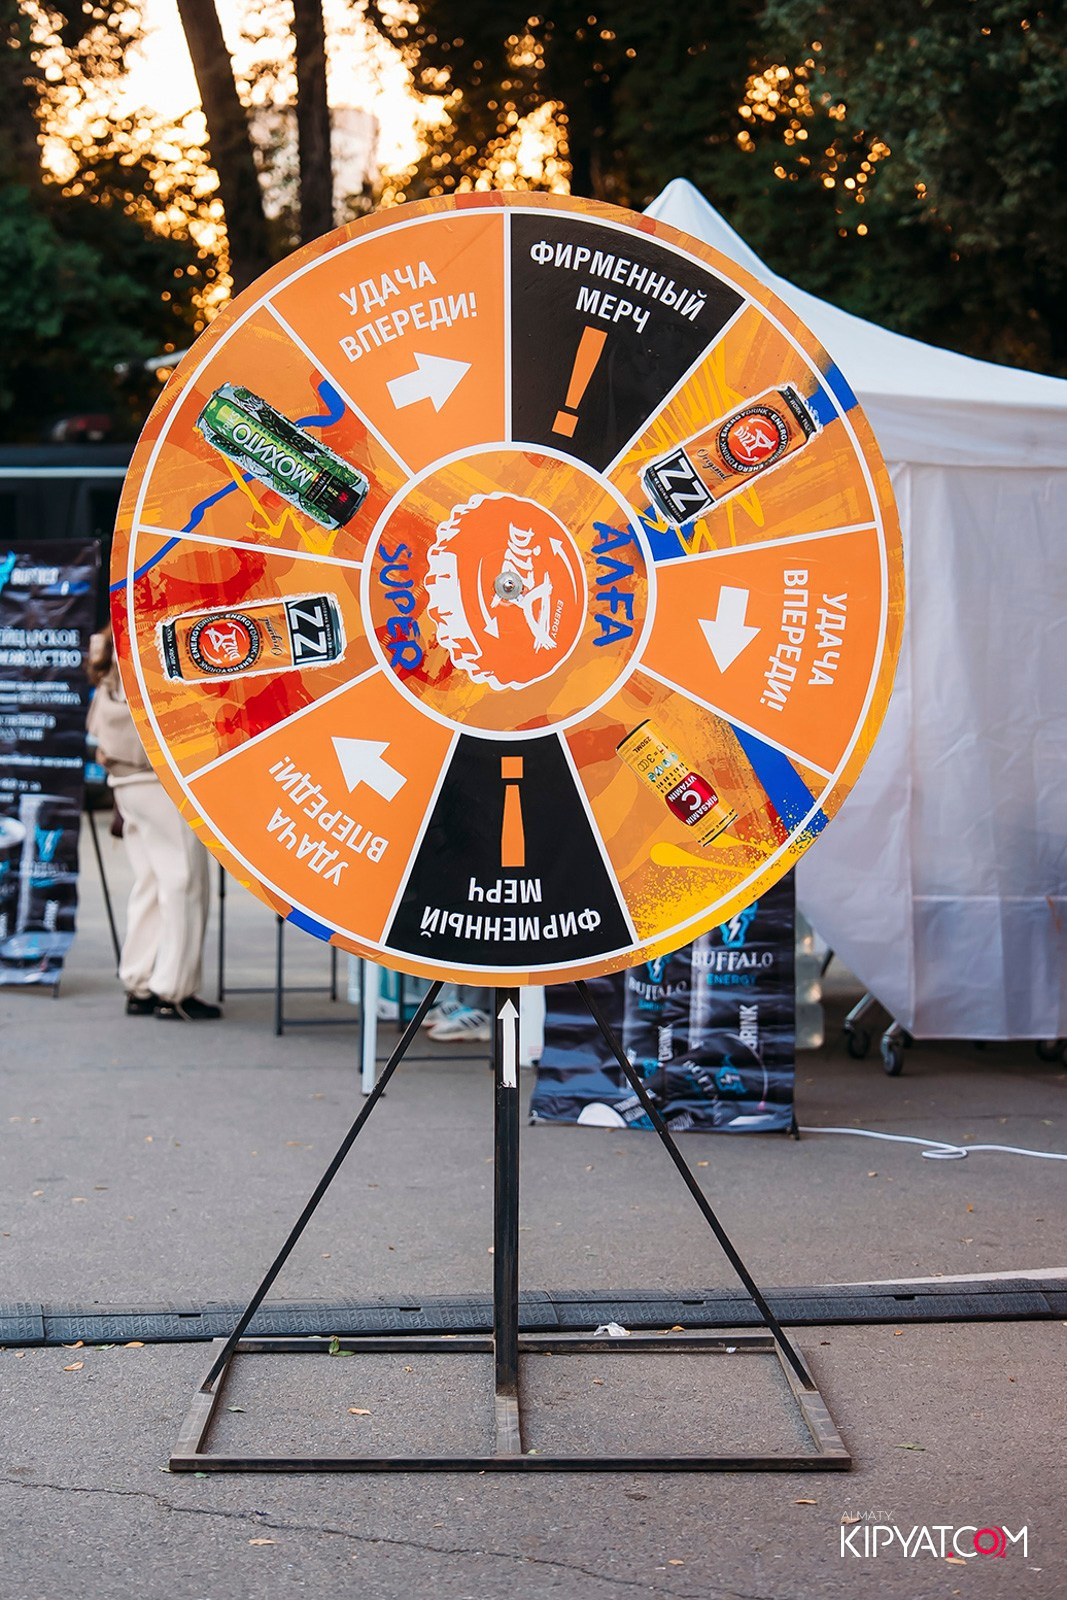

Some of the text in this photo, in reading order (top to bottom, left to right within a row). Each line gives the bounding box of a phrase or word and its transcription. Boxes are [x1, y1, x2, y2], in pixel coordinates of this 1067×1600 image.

[339, 261, 437, 316] УДАЧА
[530, 240, 708, 323] ФИРМЕННЫЙ
[338, 292, 478, 363] ВПЕРЕДИ!
[575, 286, 651, 334] МЕРЧ
[378, 542, 423, 671] SUPER
[552, 599, 564, 639] ENERGY
[759, 569, 809, 712] ВПЕРЕДИ!
[807, 593, 848, 685] УДАЧА
[632, 736, 652, 754] 250ML
[267, 755, 390, 864] ВПЕРЕДИ!
[668, 774, 698, 802] VITAMIN
[681, 790, 702, 811] C
[265, 806, 350, 886] УДАЧА
[468, 878, 542, 904] МЕРЧ
[419, 906, 602, 942] ФИРМЕННЫЙ
[691, 951, 774, 972] BUFFALO
[706, 973, 757, 986] ENERGY
[738, 1004, 759, 1050] DRINK
